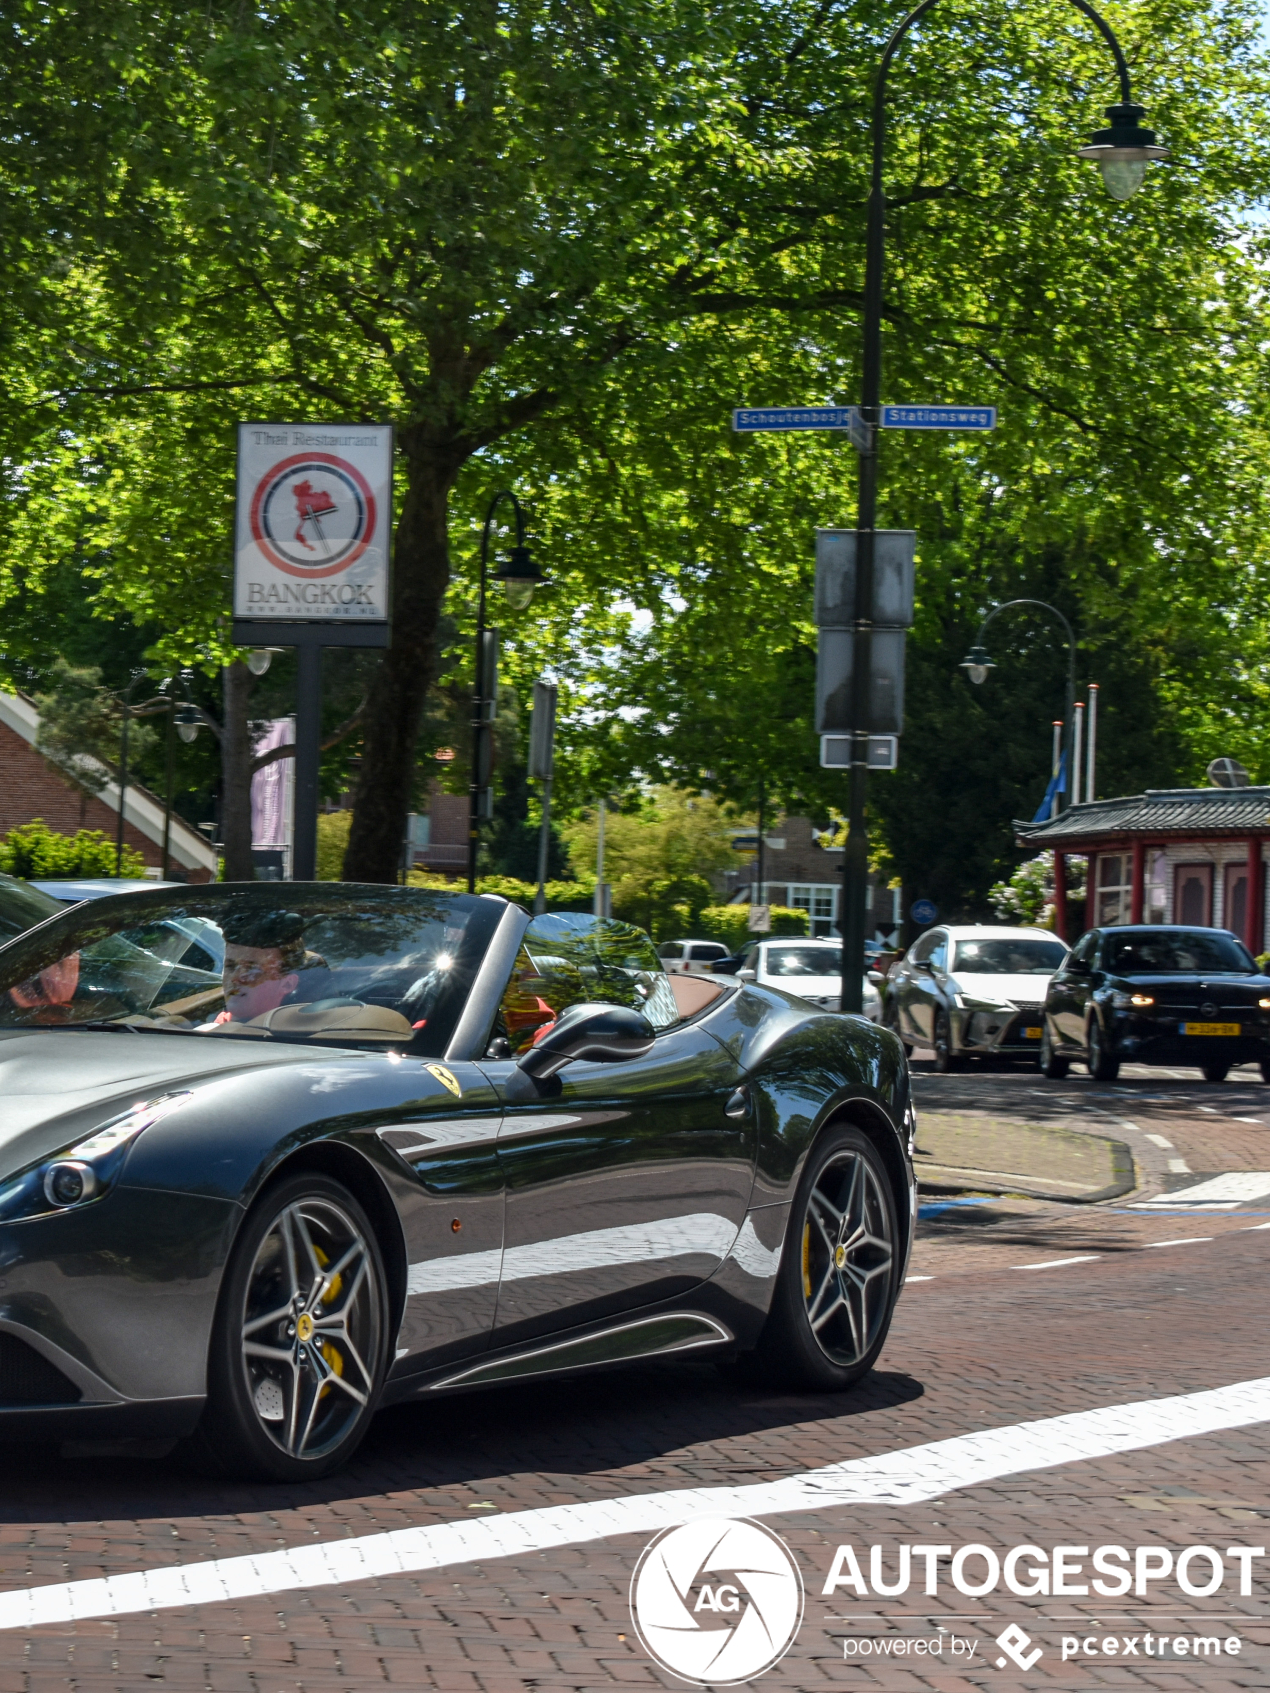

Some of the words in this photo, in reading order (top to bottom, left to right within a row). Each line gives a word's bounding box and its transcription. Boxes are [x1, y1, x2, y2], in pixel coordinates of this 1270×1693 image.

[739, 410, 851, 425] Schoutenbosje
[889, 409, 988, 425] Stationsweg
[252, 431, 288, 446] Thai
[292, 431, 378, 447] Restaurant
[246, 582, 376, 605] BANGKOK
